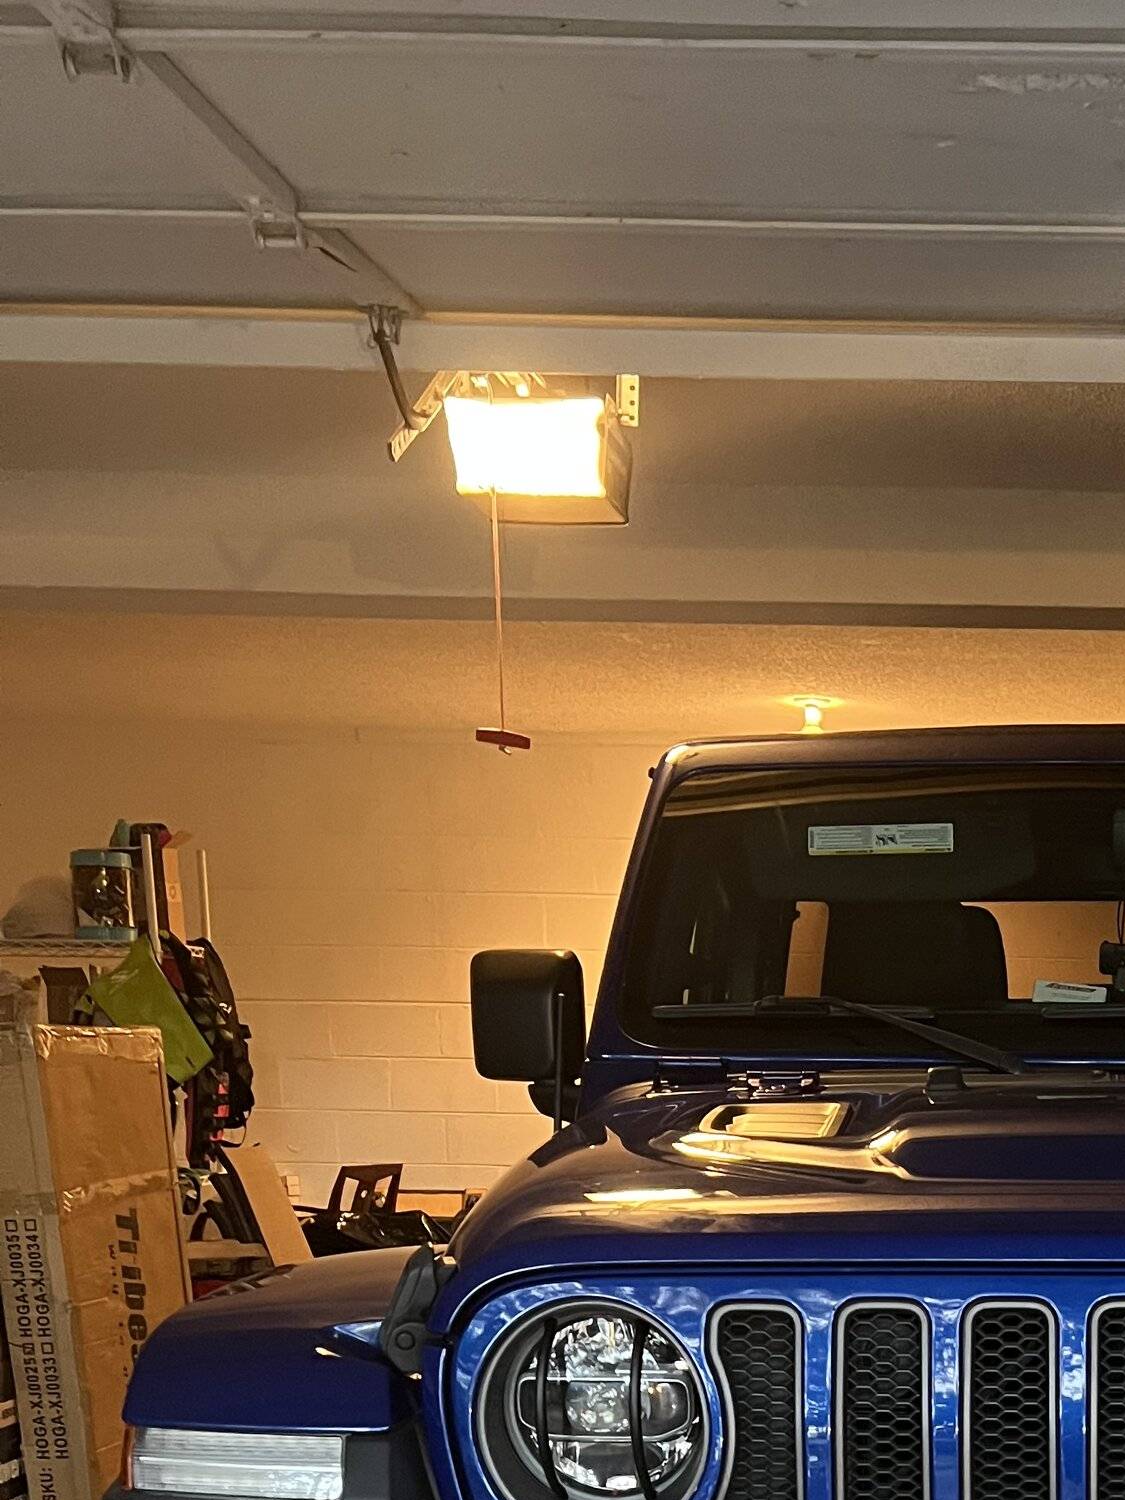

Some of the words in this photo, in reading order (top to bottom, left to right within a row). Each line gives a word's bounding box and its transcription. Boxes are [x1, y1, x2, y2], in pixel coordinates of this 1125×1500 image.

[6, 1234, 33, 1338] HOGA-XJ0035
[25, 1234, 52, 1338] HOGA-XJ0034
[115, 1207, 148, 1366] Tribe
[23, 1357, 51, 1460] HOGA-XJ0025
[42, 1357, 70, 1460] HOGA-XJ0033
